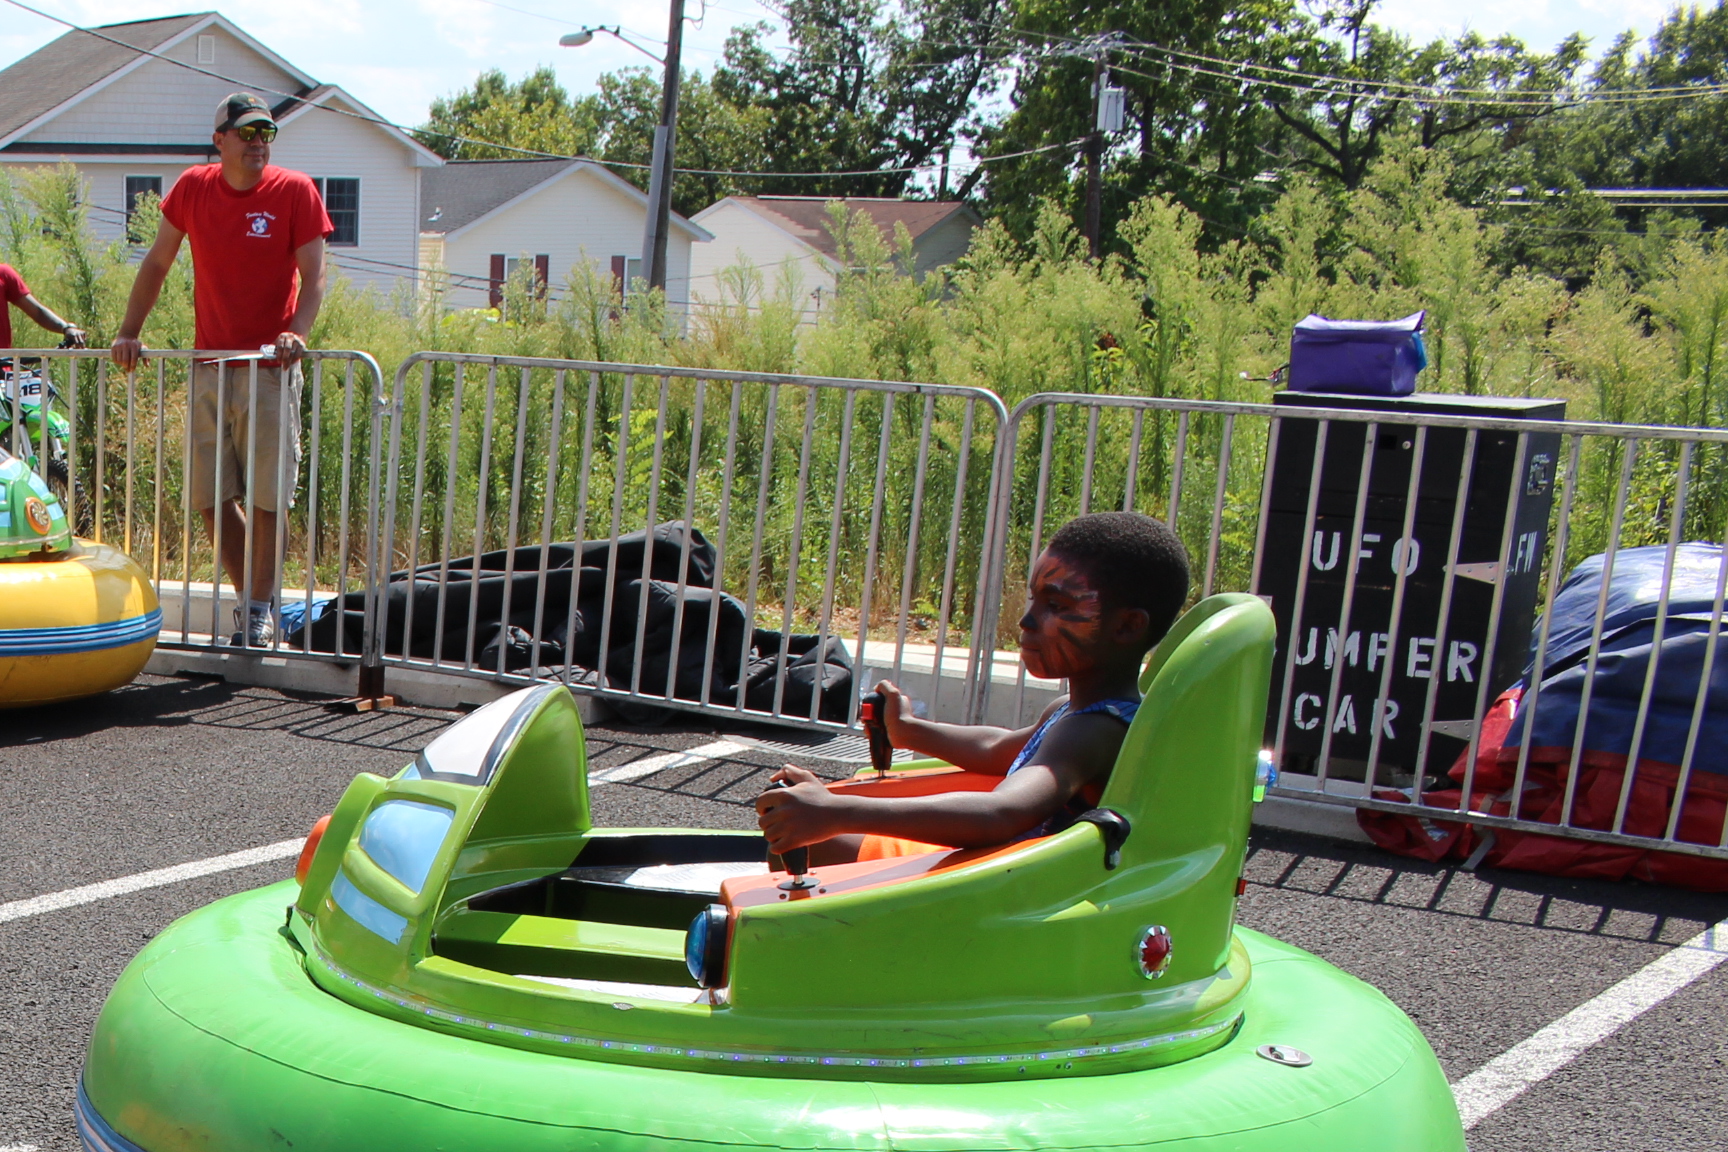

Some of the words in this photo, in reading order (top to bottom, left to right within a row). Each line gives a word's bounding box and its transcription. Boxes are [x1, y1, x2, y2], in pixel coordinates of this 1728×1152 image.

[1312, 531, 1420, 577] UFO
[1294, 627, 1478, 682] UMPER
[1294, 692, 1400, 739] CAR
